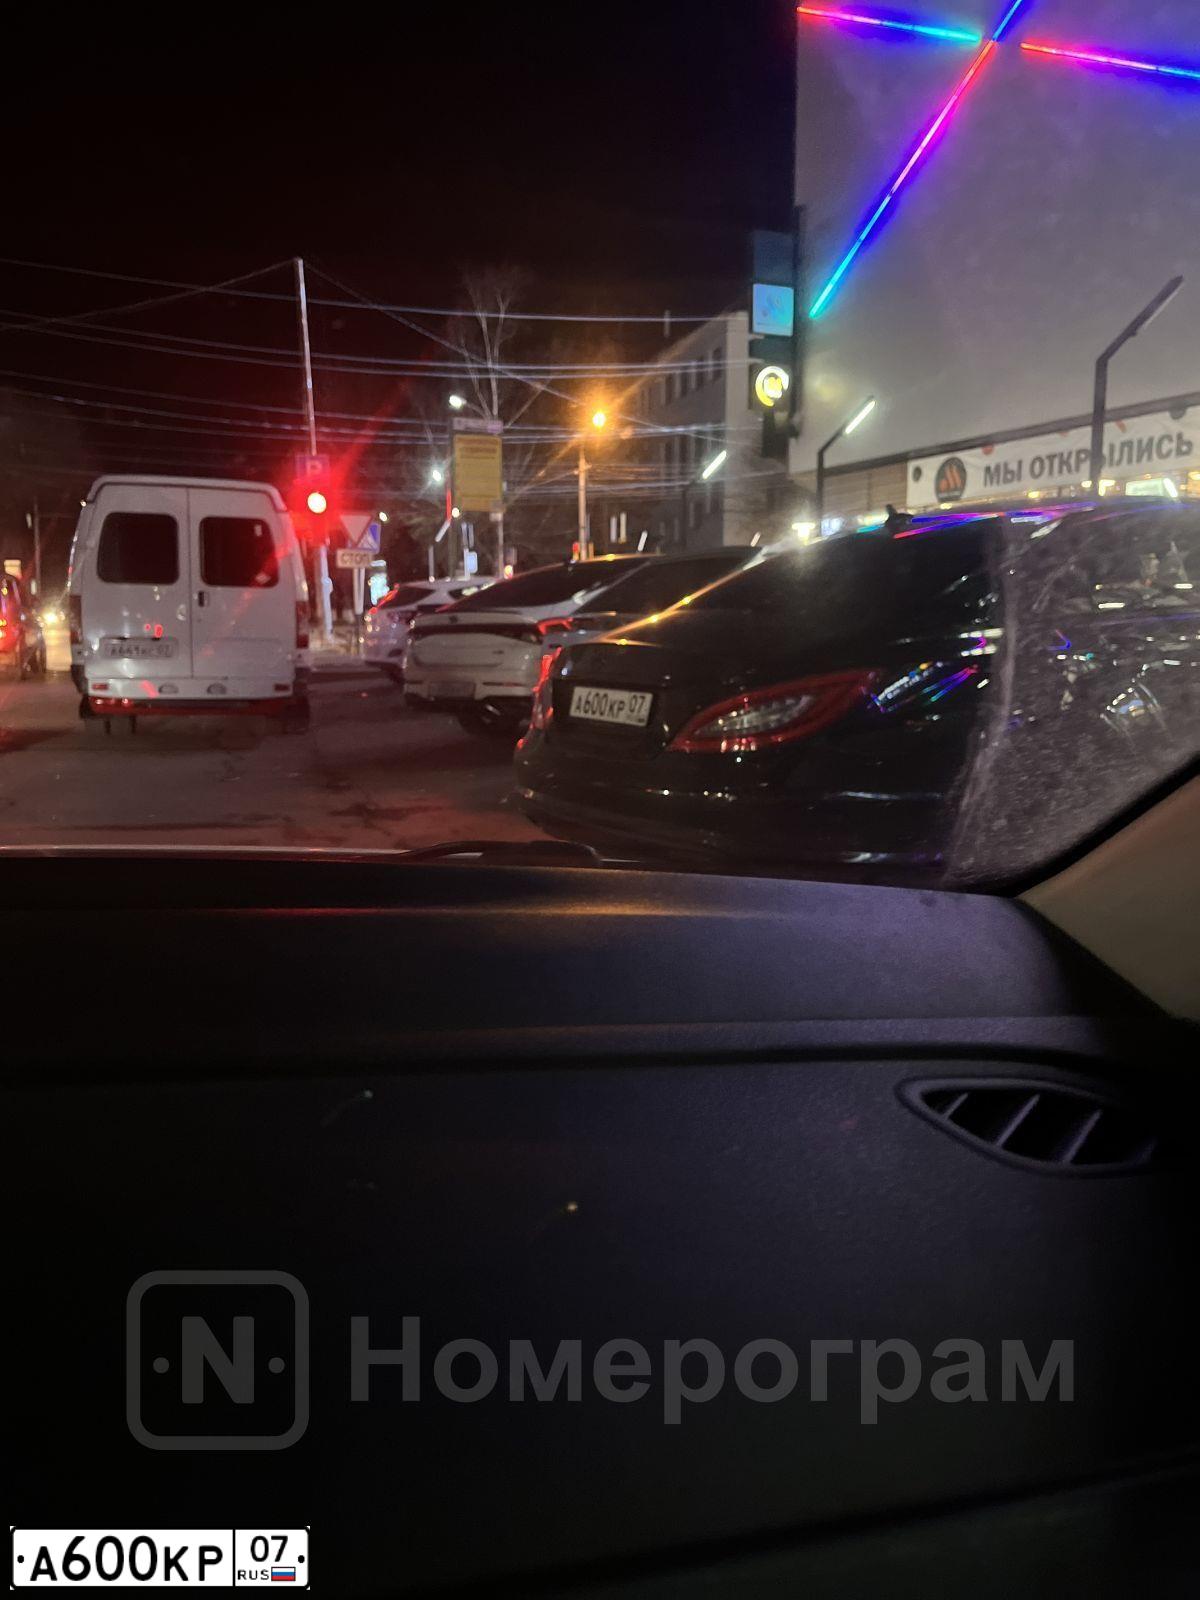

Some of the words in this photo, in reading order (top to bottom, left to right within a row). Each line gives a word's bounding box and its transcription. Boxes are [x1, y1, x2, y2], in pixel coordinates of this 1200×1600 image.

[983, 460, 1022, 488] МЫ
[574, 691, 625, 719] А600КР
[629, 694, 646, 713] 07
